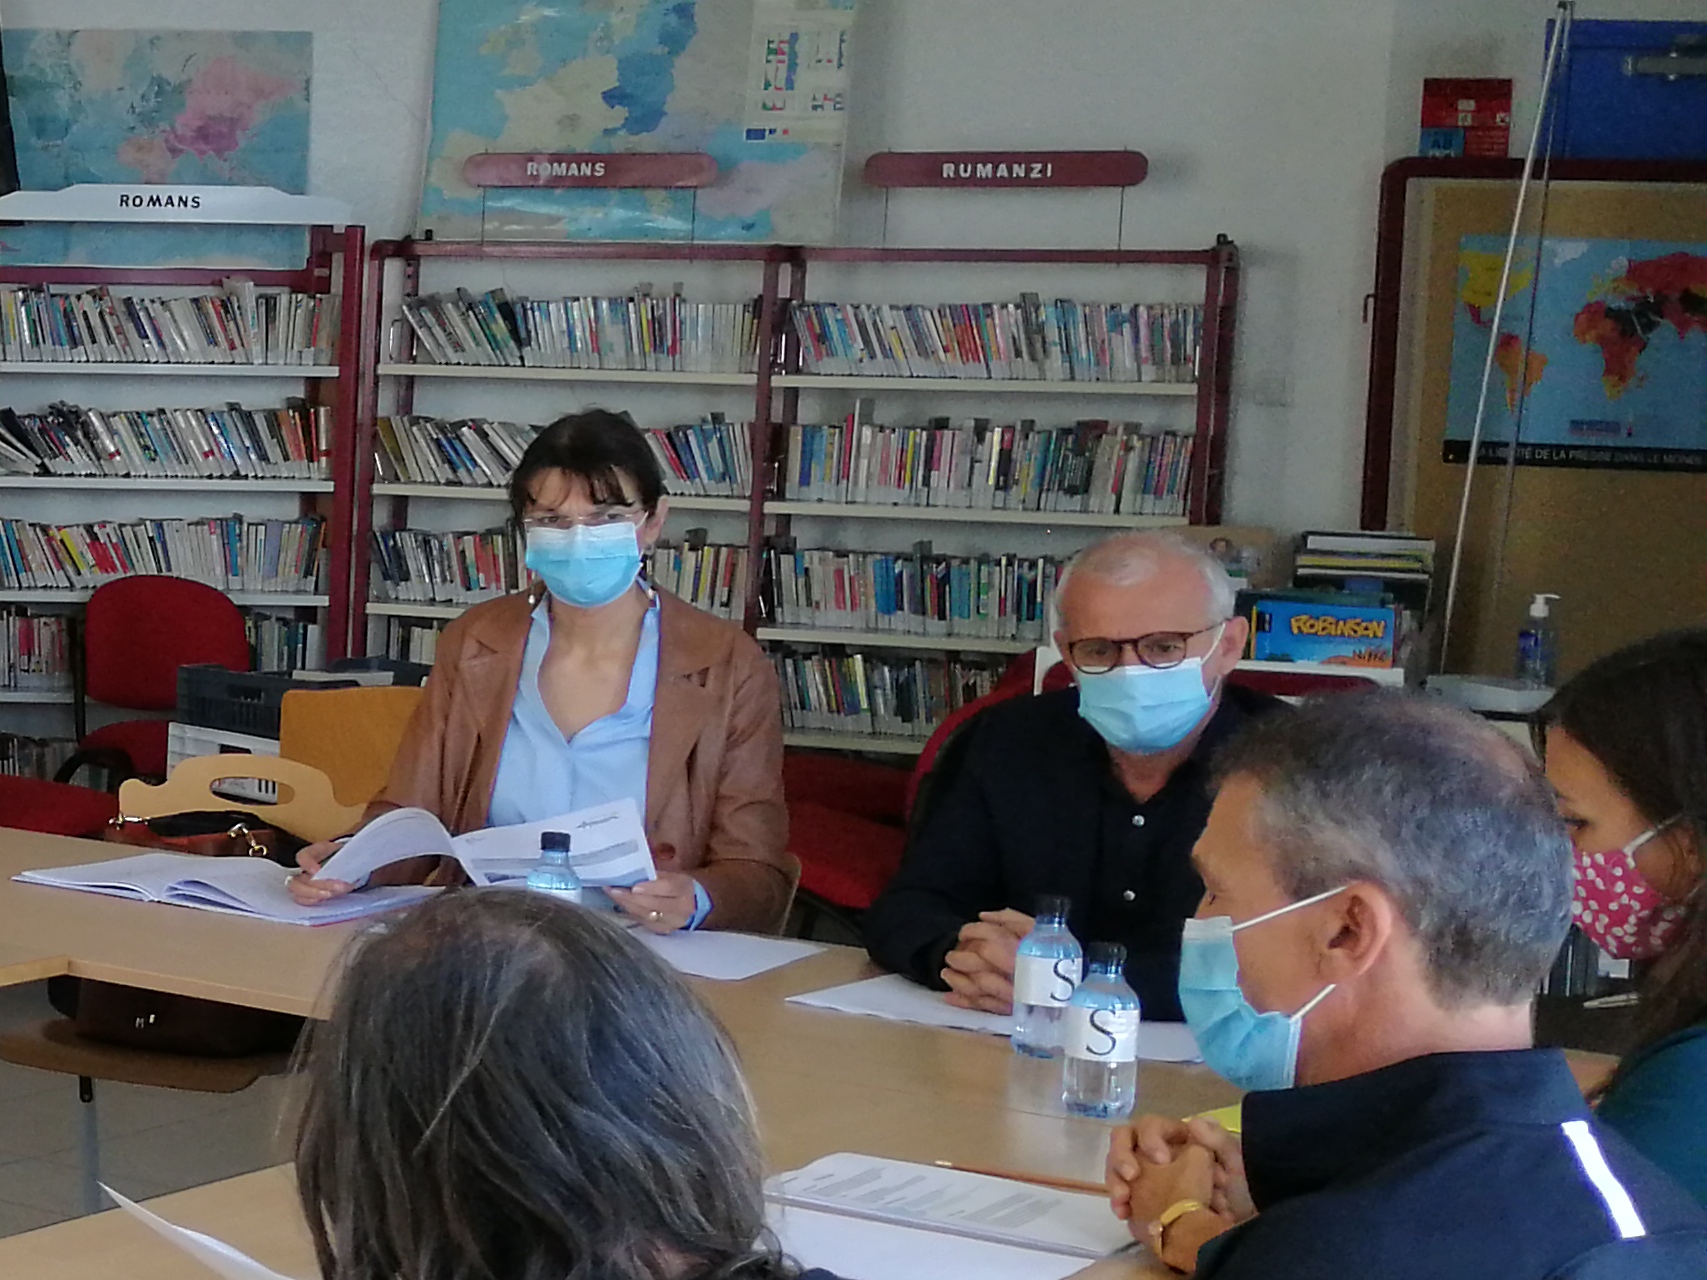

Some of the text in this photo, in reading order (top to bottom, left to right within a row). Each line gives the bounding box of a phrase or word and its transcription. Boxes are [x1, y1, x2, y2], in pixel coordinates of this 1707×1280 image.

[527, 161, 605, 177] ROMANS
[942, 162, 1053, 179] RUMANZI
[119, 193, 201, 209] ROMANS
